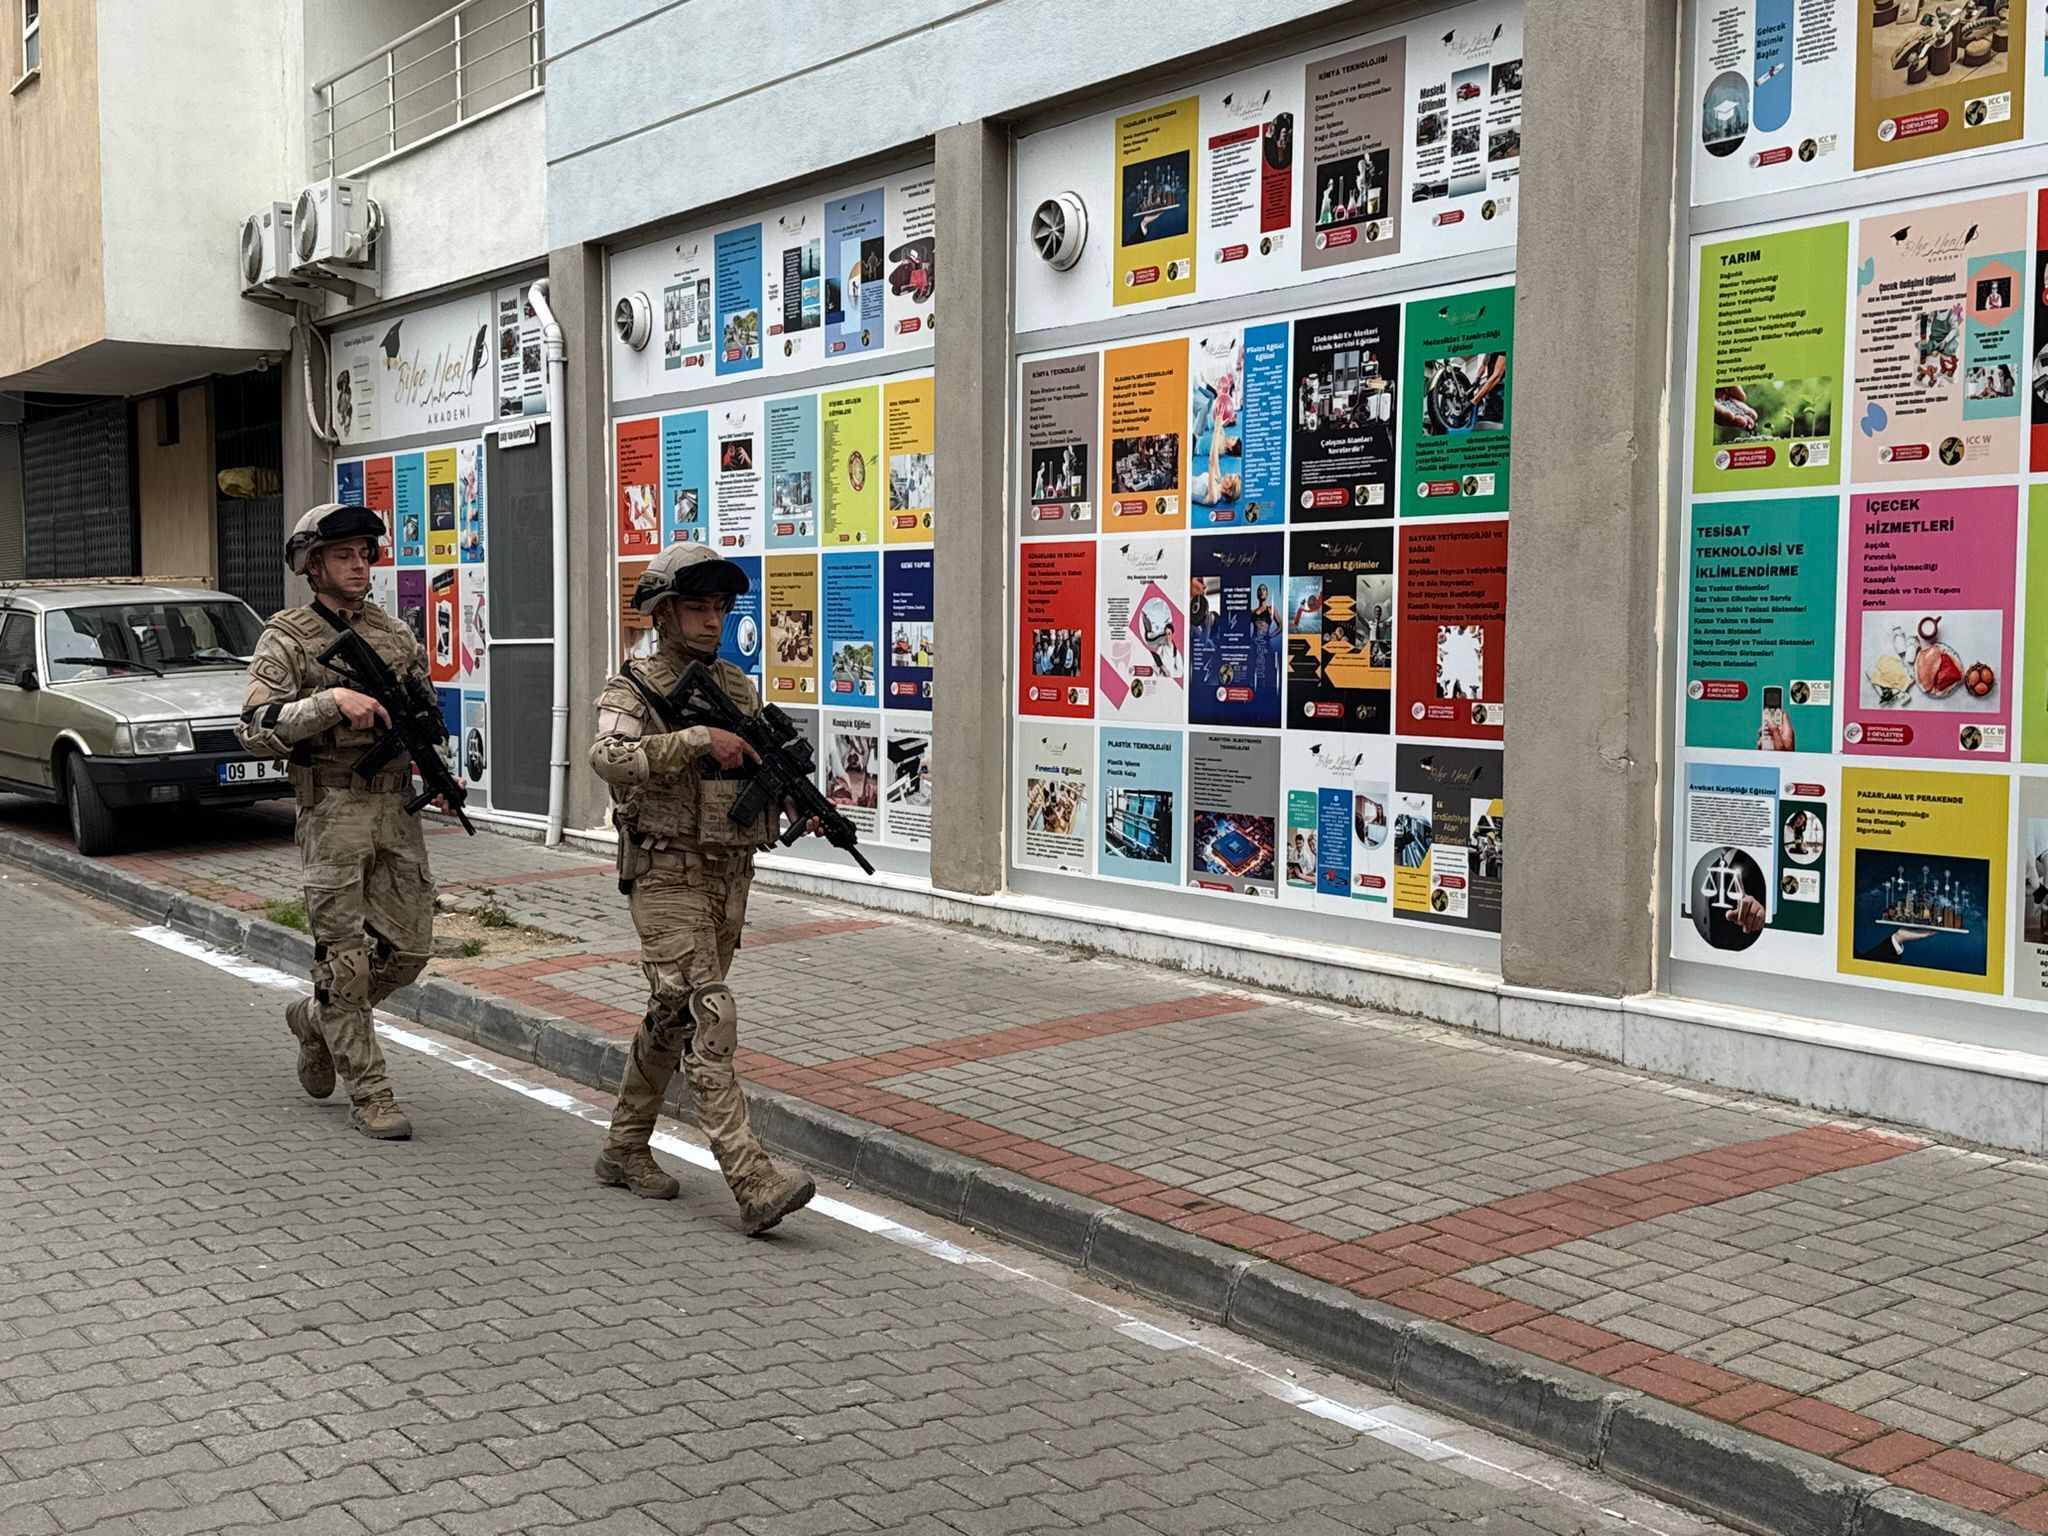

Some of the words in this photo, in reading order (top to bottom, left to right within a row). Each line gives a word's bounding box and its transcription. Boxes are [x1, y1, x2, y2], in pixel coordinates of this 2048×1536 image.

[1756, 22, 1786, 36] Gelecek
[1756, 35, 1784, 48] Bizimle
[1756, 48, 1779, 60] Başlar
[1318, 68, 1340, 80] KİMYA
[1342, 55, 1387, 73] TEKNOLOJİSİ
[1419, 82, 1446, 98] Mesleki
[1720, 250, 1761, 265] TARIM
[1879, 282, 1897, 295] Çocuk
[428, 404, 470, 424] AKADEMİ
[1966, 436, 1981, 445] ICC
[1982, 435, 1991, 443] W
[1866, 496, 1919, 515] İÇECEK
[1696, 522, 1750, 538] TESİSAT
[1864, 516, 1954, 535] HİZMETLERİ
[1695, 542, 1781, 558] TEKNOLOJİSİ
[1786, 544, 1804, 555] VE
[1308, 560, 1340, 570] Finansal
[1695, 562, 1798, 578] İKLİMLENDİRME
[1902, 587, 1911, 595] ve
[228, 763, 245, 779] 09
[257, 763, 265, 778] B
[1856, 790, 1902, 800] PAZARLAMA
[1904, 793, 1914, 801] VE
[1916, 794, 1963, 804] PERAKENDE
